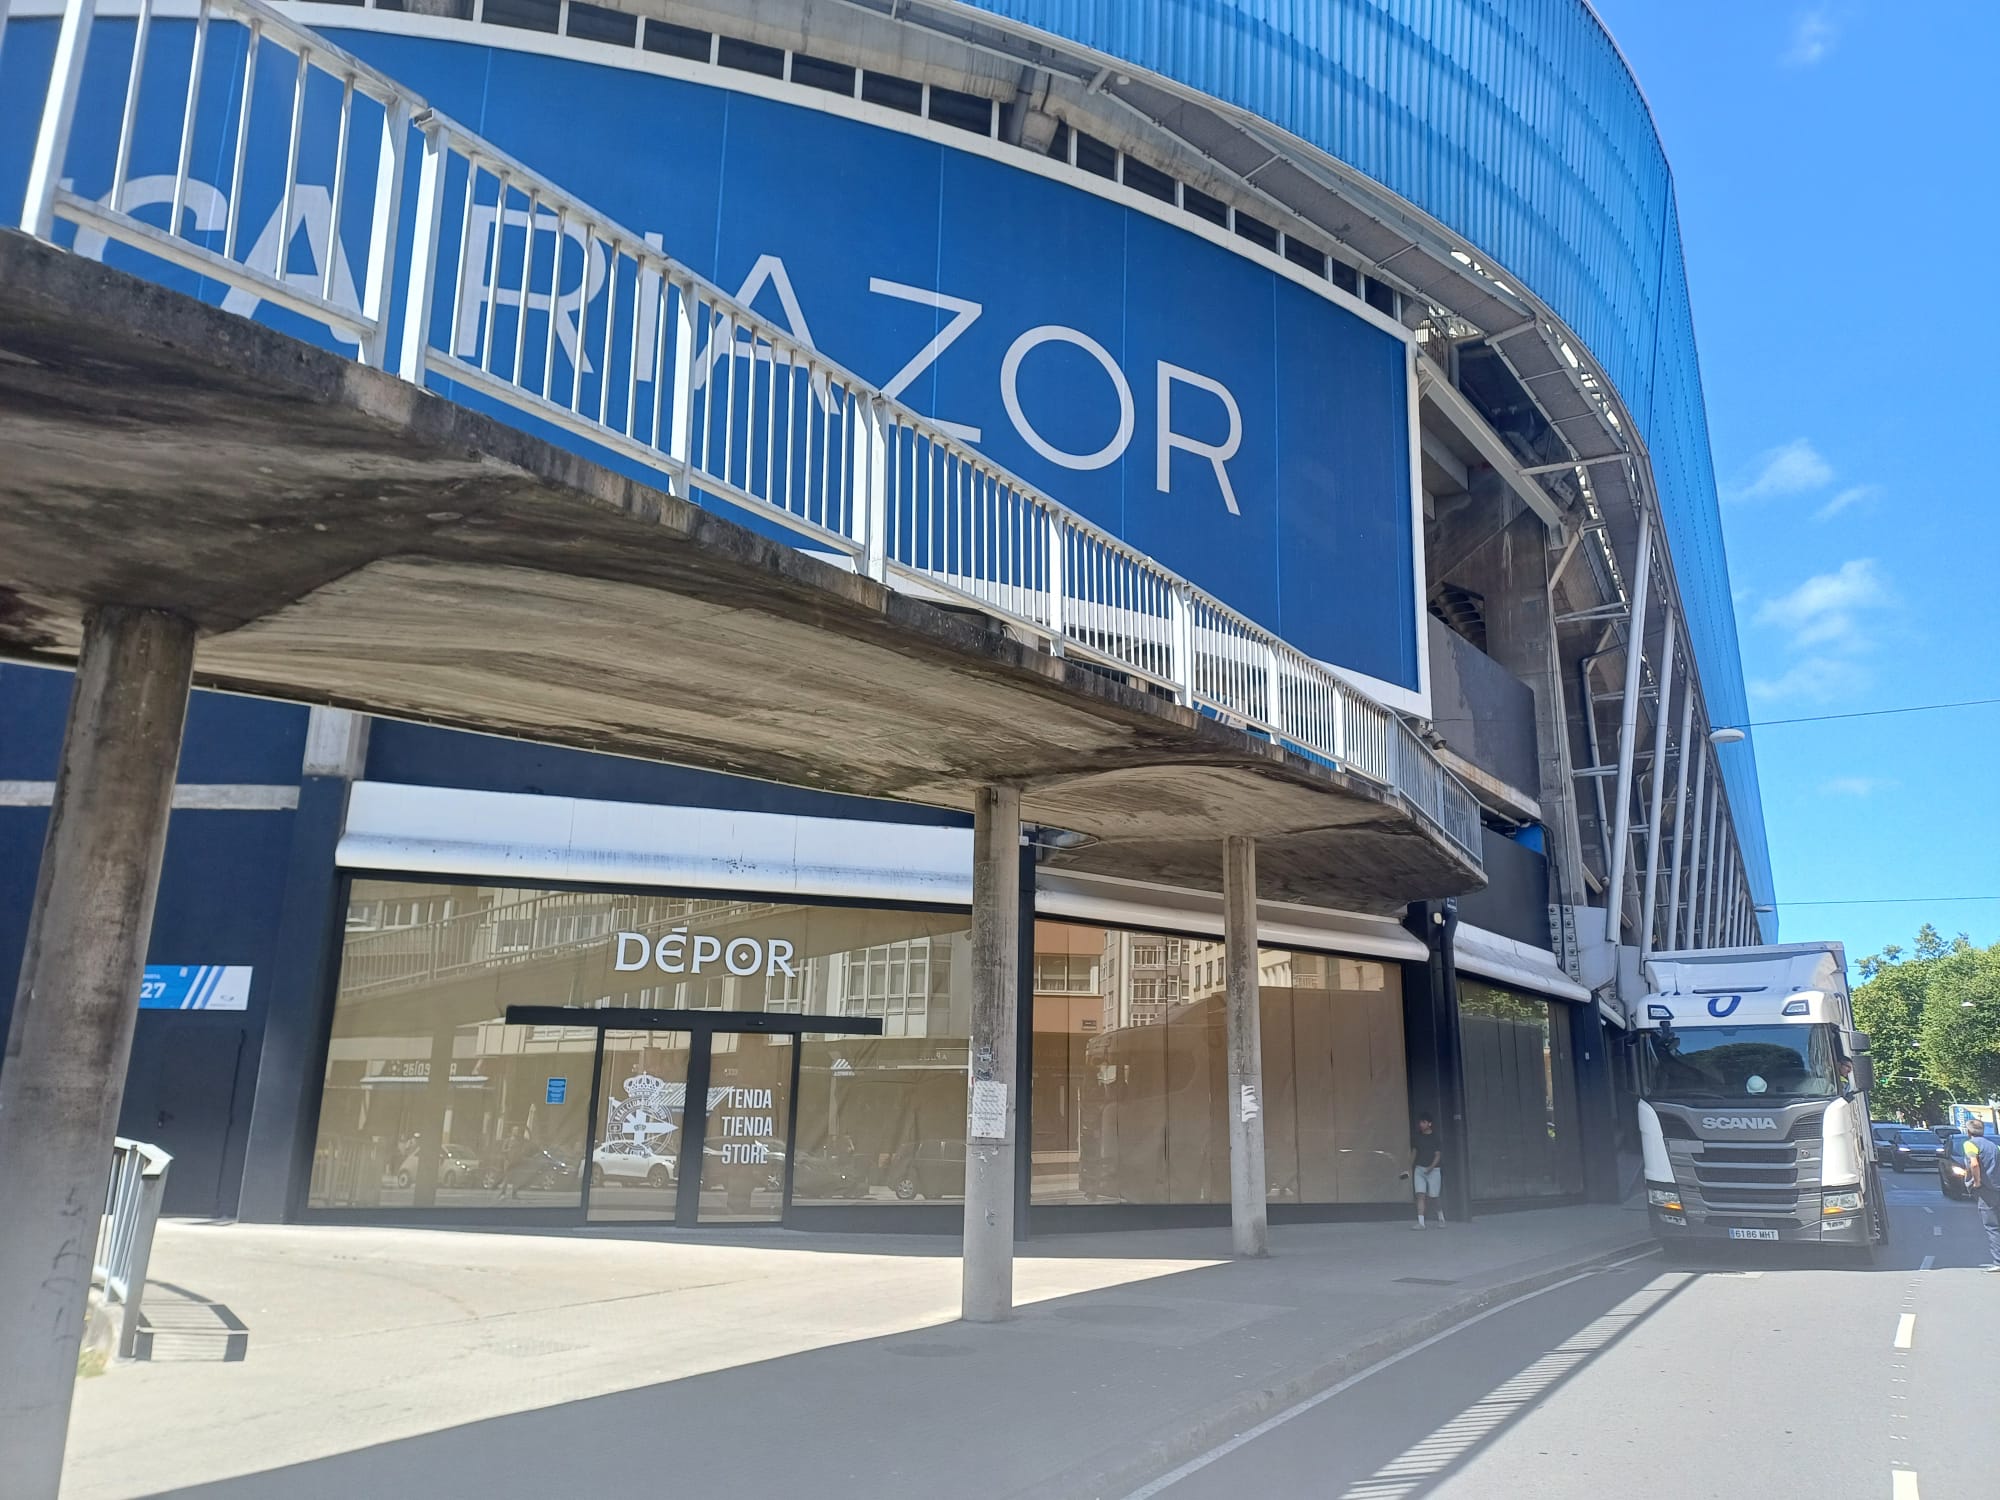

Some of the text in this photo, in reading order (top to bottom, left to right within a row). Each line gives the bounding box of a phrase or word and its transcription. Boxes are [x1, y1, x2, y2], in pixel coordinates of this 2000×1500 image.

[457, 204, 1243, 516] RIAZOR
[614, 927, 796, 978] DÉPOR
[728, 1088, 772, 1109] TENDA
[721, 1116, 773, 1137] TIENDA
[1702, 1117, 1776, 1129] SCANIA
[721, 1143, 769, 1164] STORE
